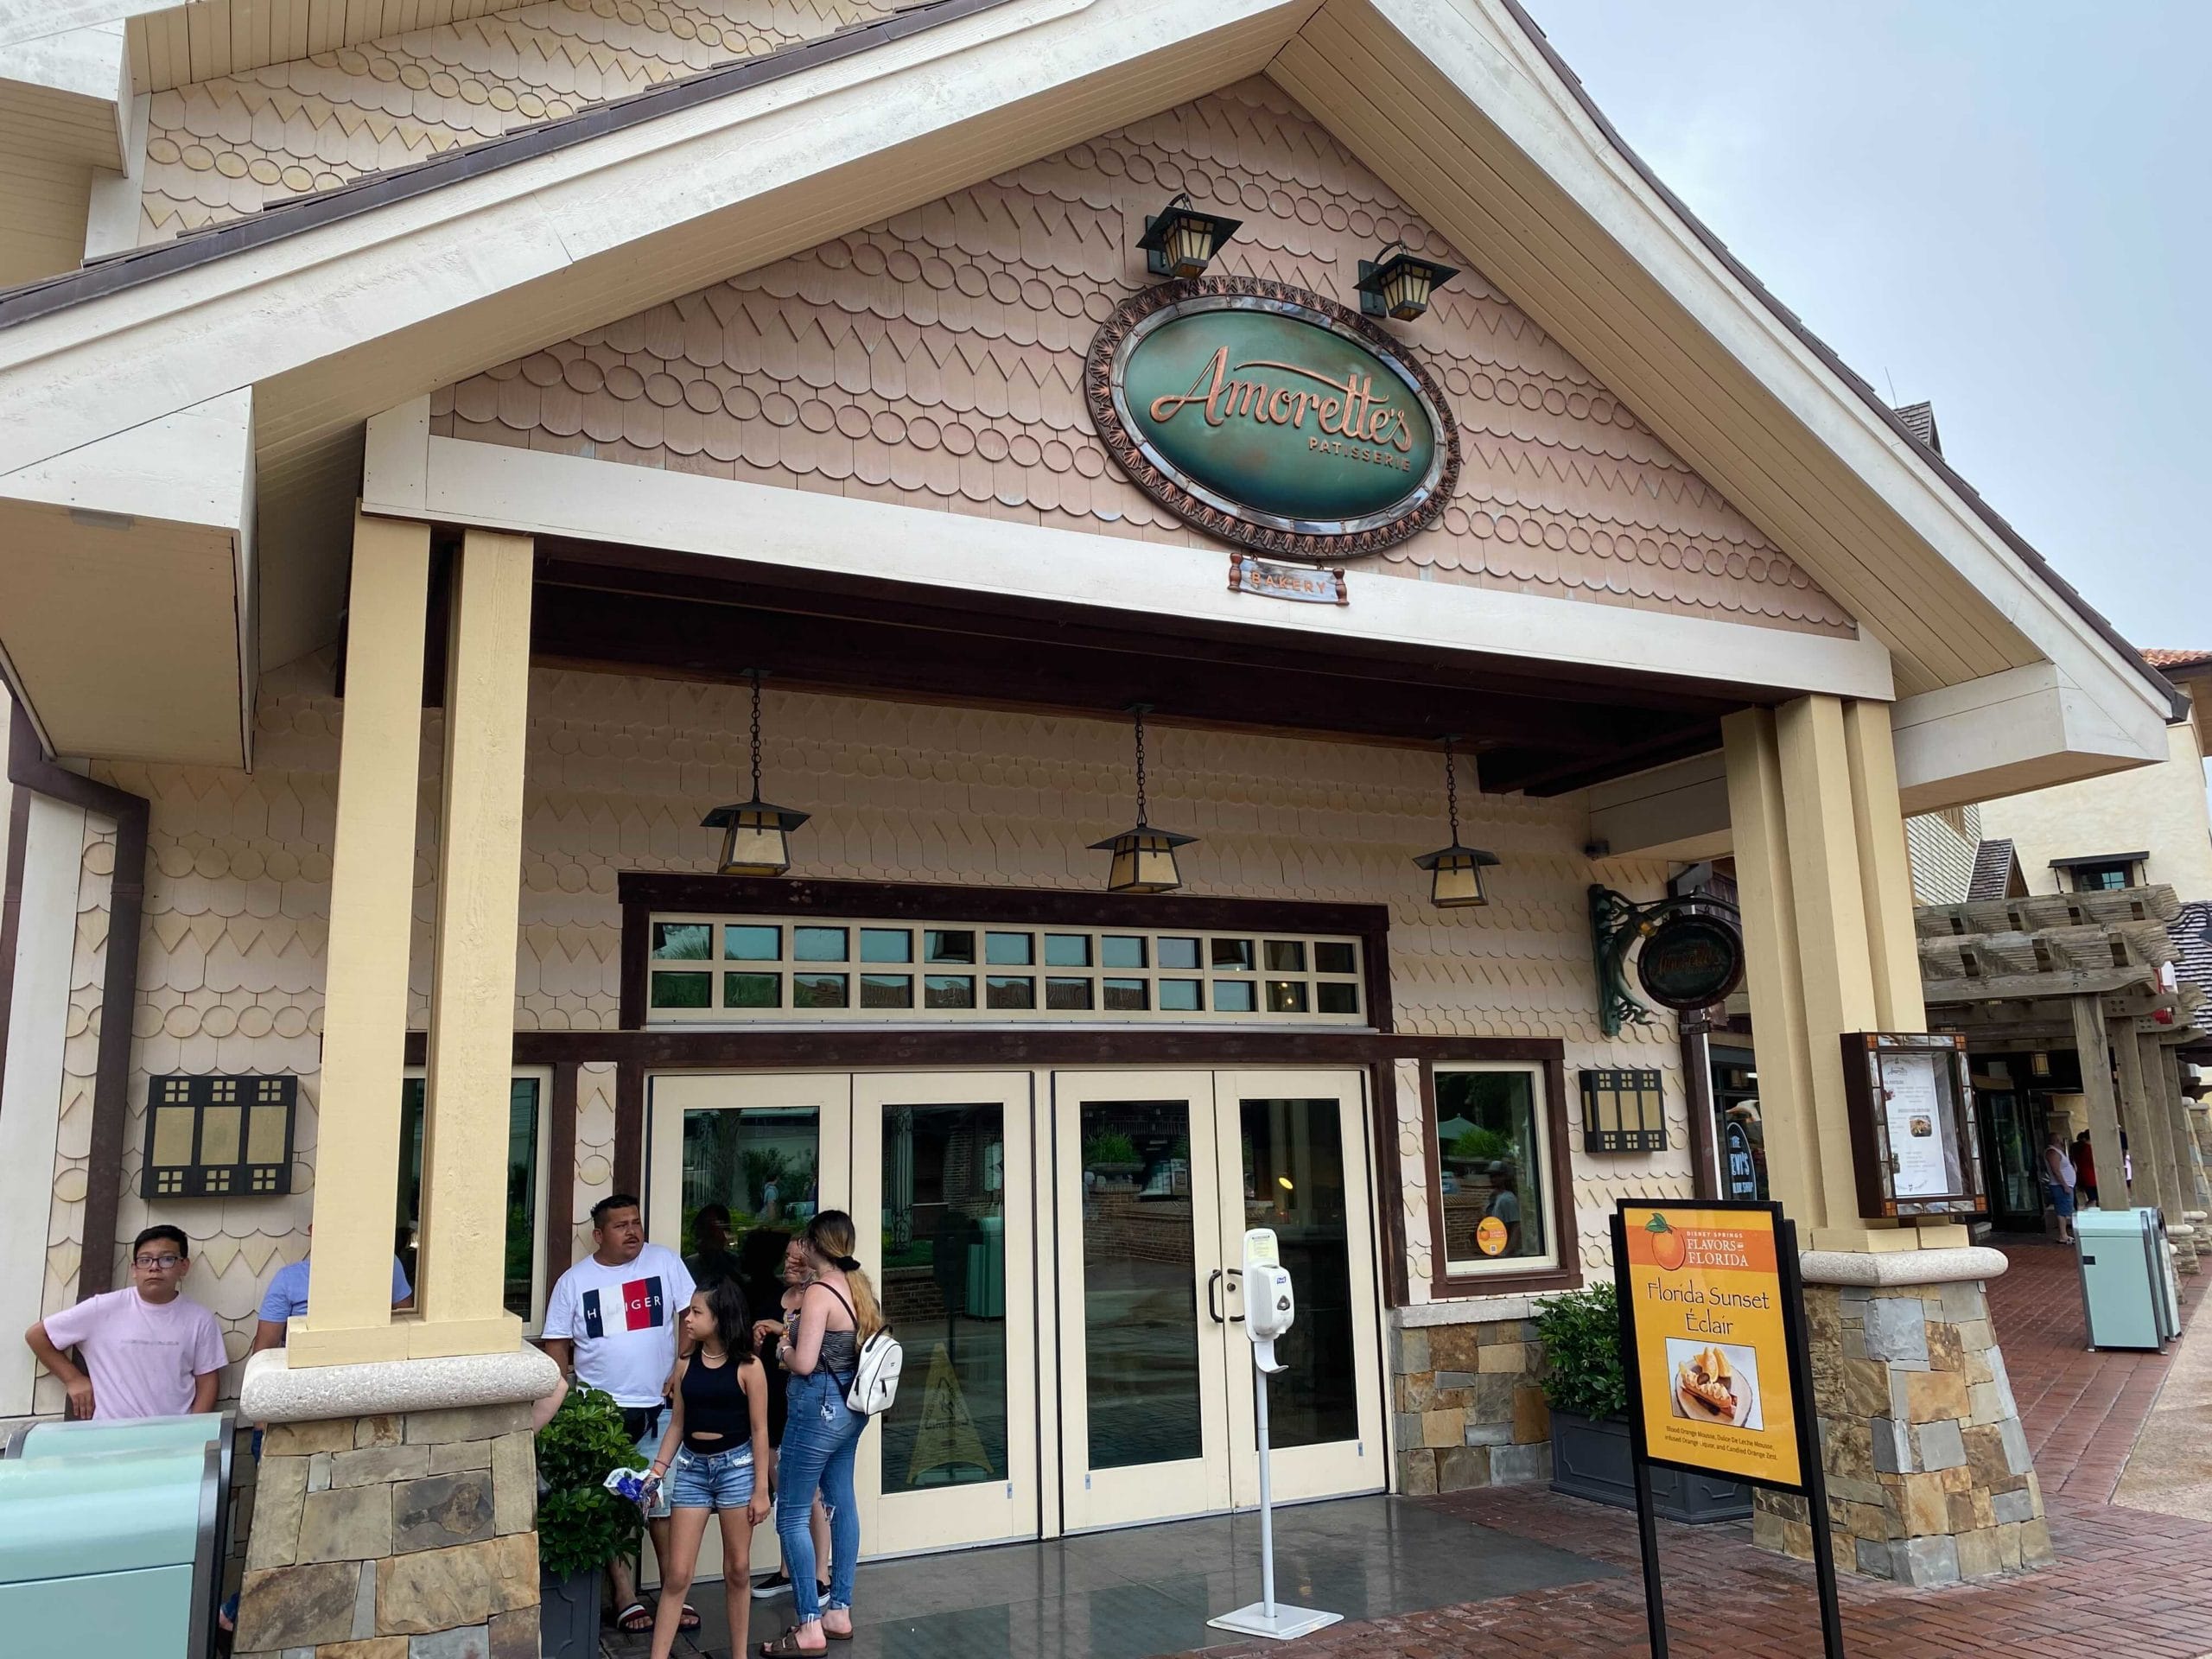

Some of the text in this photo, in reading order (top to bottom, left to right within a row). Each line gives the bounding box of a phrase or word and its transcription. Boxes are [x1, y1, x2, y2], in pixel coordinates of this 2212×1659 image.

[1150, 346, 1413, 453] Amorette's
[1308, 435, 1412, 473] PATISSERIE
[1250, 570, 1325, 594] BAKERY
[1730, 1151, 1750, 1176] EVI'S
[1687, 1238, 1737, 1252] FLAVORS
[1688, 1251, 1750, 1267] FLORIDA
[1648, 1276, 1770, 1309] Florida Sunset
[588, 1295, 662, 1320] HLFIGER
[1686, 1308, 1734, 1335] Éclair
[1681, 1427, 1697, 1437] Orange
[1682, 1438, 1698, 1447] Orange
[1747, 1448, 1765, 1459] Orange
